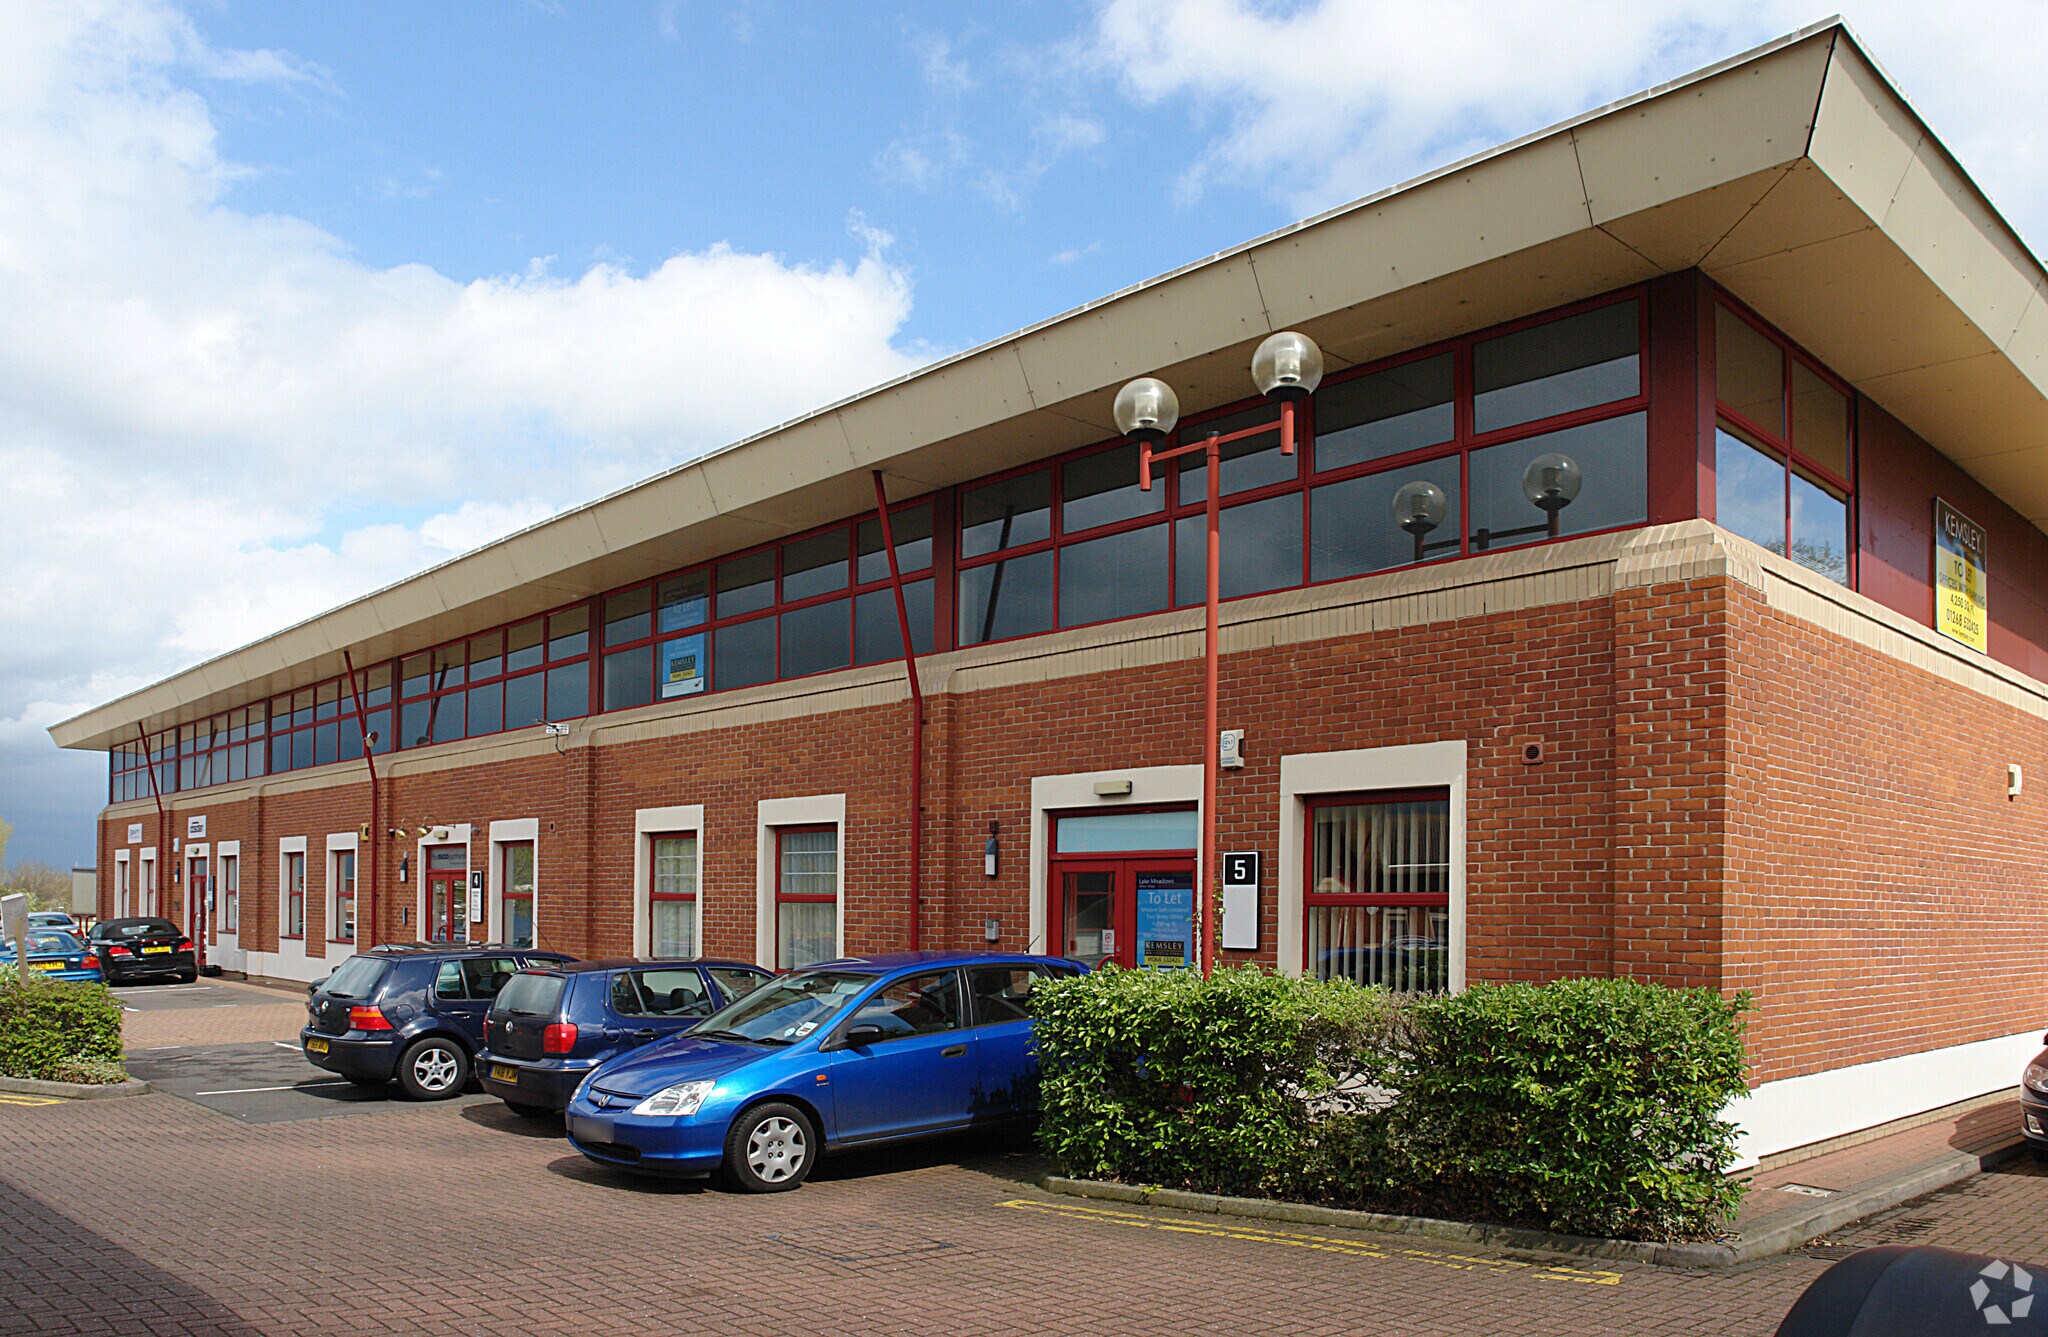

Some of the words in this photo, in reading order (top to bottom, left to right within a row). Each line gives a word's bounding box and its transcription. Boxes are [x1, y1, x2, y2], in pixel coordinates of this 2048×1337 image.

[1945, 511, 1981, 552] KEMSLEY
[1954, 560, 1963, 578] TO
[1234, 860, 1246, 880] 5
[474, 875, 479, 886] 4
[1148, 892, 1161, 905] To
[1165, 892, 1182, 905] Let
[1145, 941, 1183, 950] KEMSLEY
